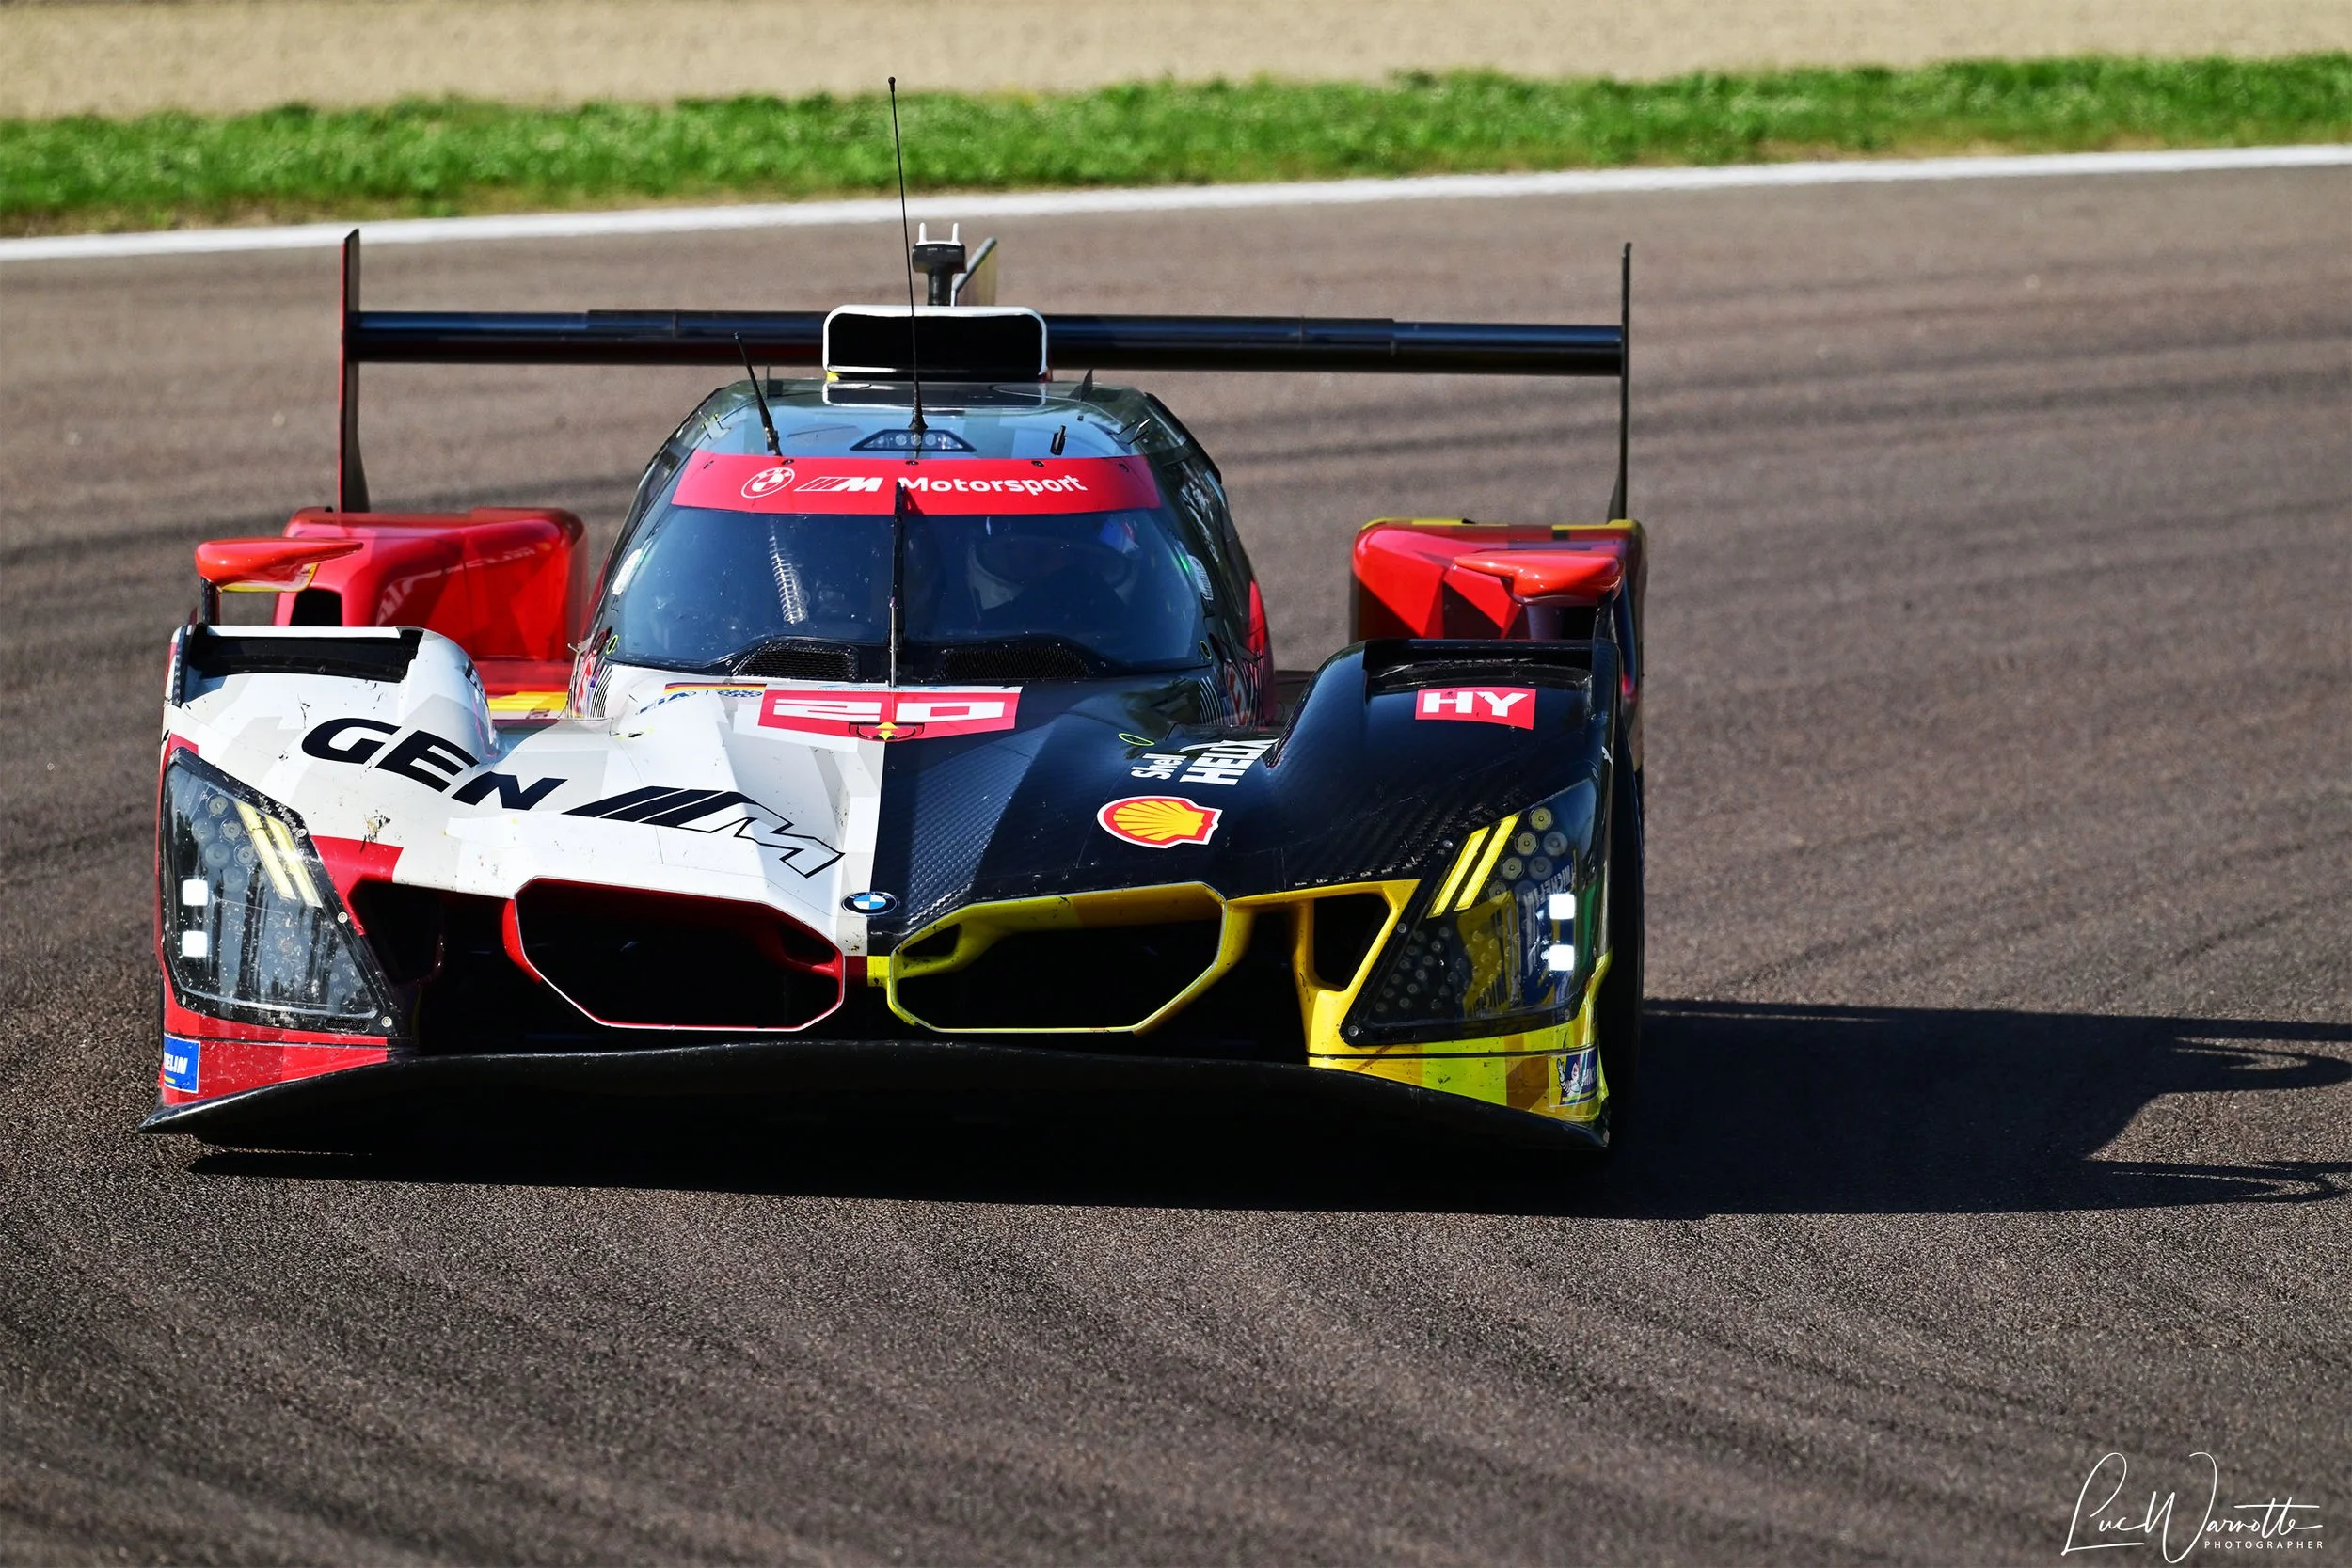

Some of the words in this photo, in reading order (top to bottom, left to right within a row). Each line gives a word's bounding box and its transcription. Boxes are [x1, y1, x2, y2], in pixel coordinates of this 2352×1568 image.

[898, 475, 1089, 496] Motorsport
[772, 698, 1006, 723] 20
[1422, 691, 1529, 718] HY
[301, 717, 568, 811] GEN
[1130, 752, 1188, 781] Shell
